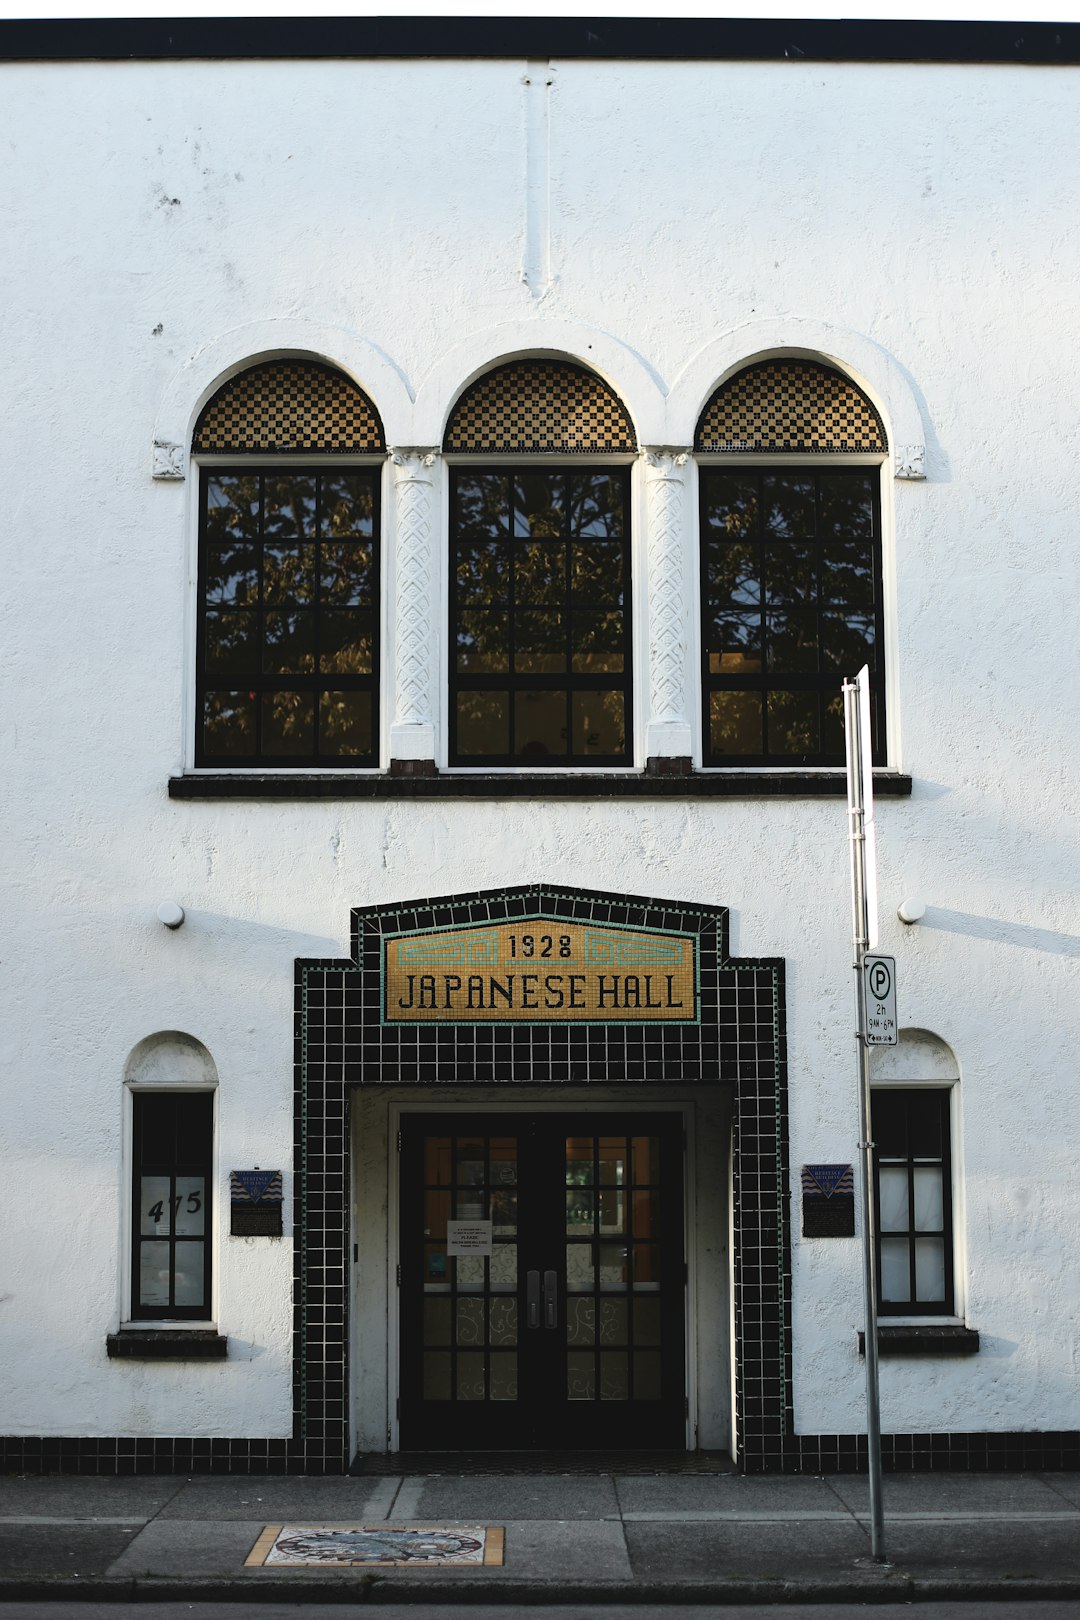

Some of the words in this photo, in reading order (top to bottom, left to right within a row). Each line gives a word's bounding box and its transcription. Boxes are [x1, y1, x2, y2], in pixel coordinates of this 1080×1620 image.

[508, 935, 572, 958] 1928
[398, 975, 586, 1008] JAPANESE
[596, 975, 683, 1008] HALL
[876, 970, 886, 991] P
[876, 1003, 886, 1015] 2h
[148, 1190, 202, 1223] 475
